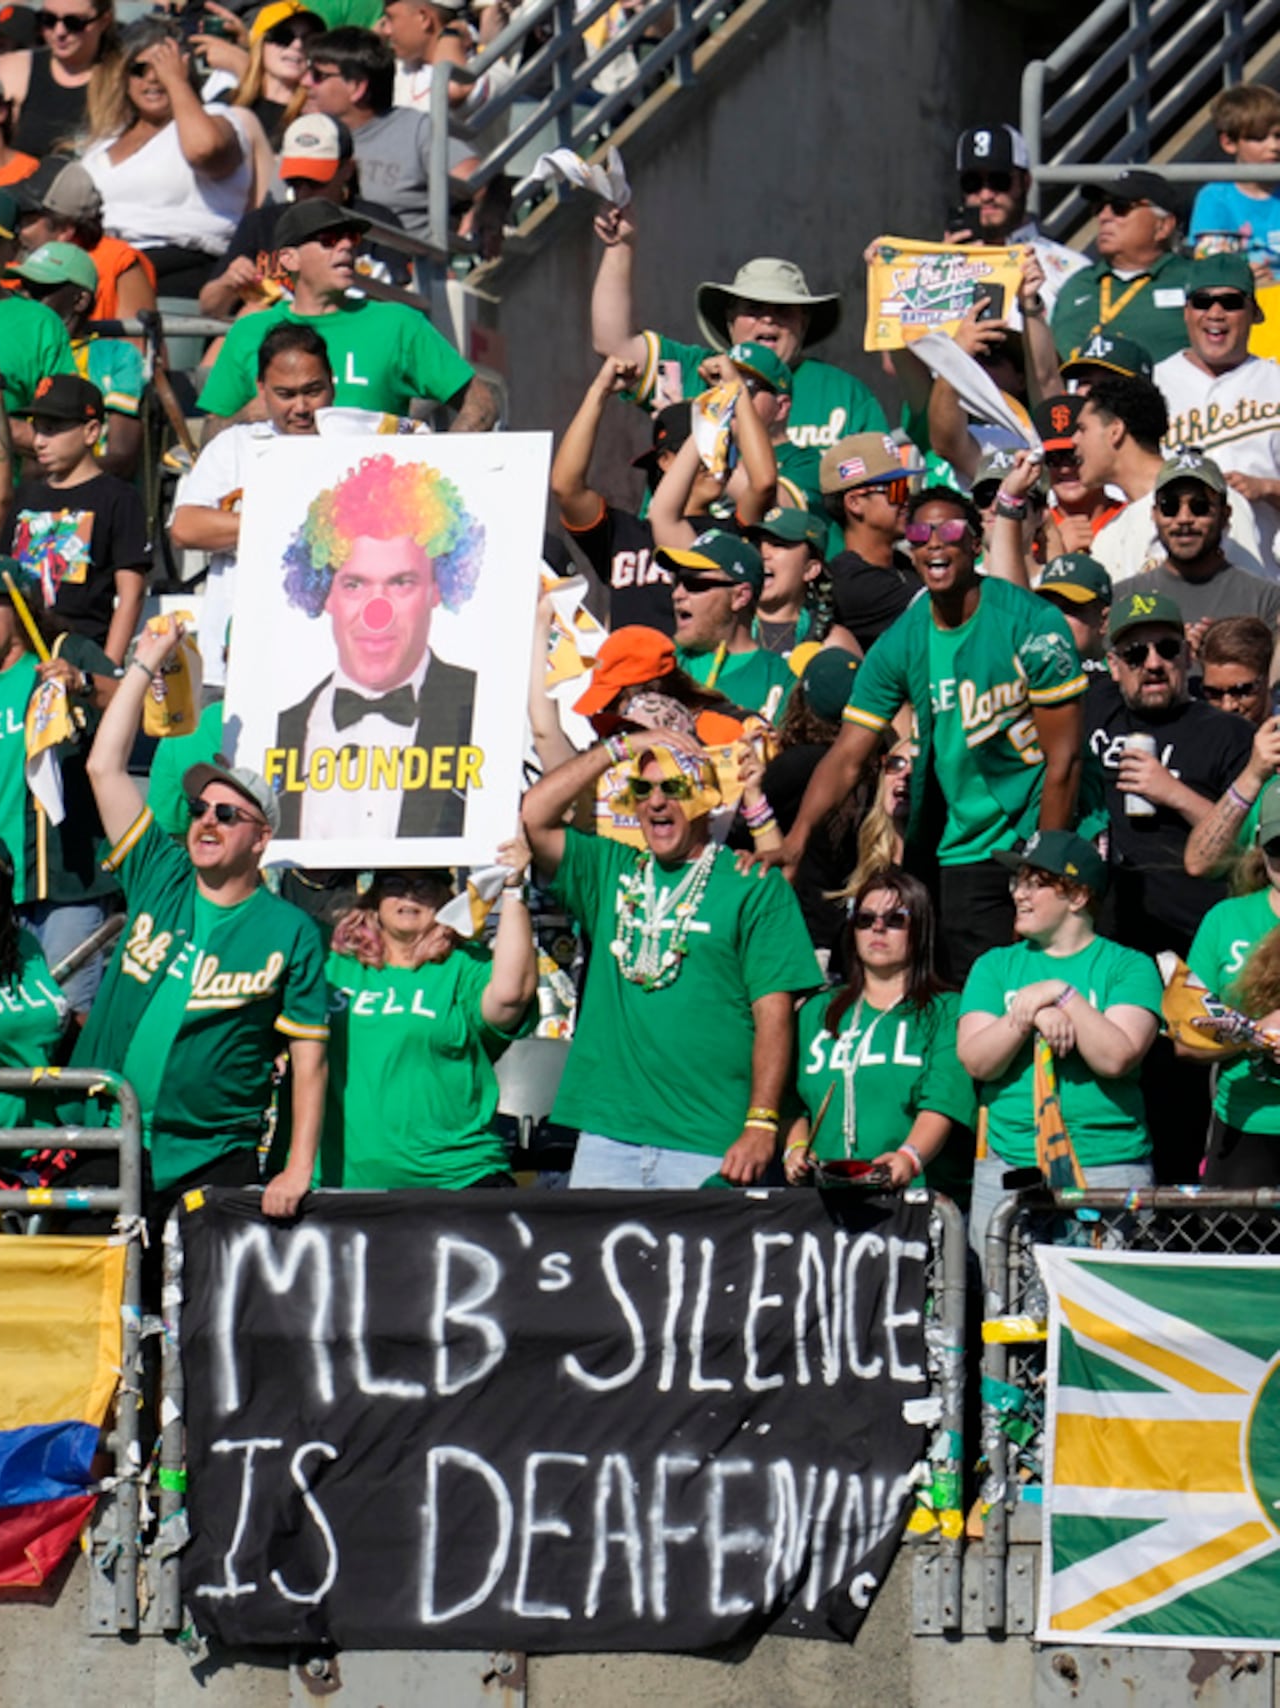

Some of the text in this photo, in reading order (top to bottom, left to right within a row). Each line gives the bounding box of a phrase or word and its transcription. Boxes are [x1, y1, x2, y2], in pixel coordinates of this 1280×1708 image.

[264, 745, 486, 793] FLOUNDER
[190, 951, 284, 998] land
[563, 1220, 927, 1393] SILENCE
[194, 1437, 340, 1605] IS
